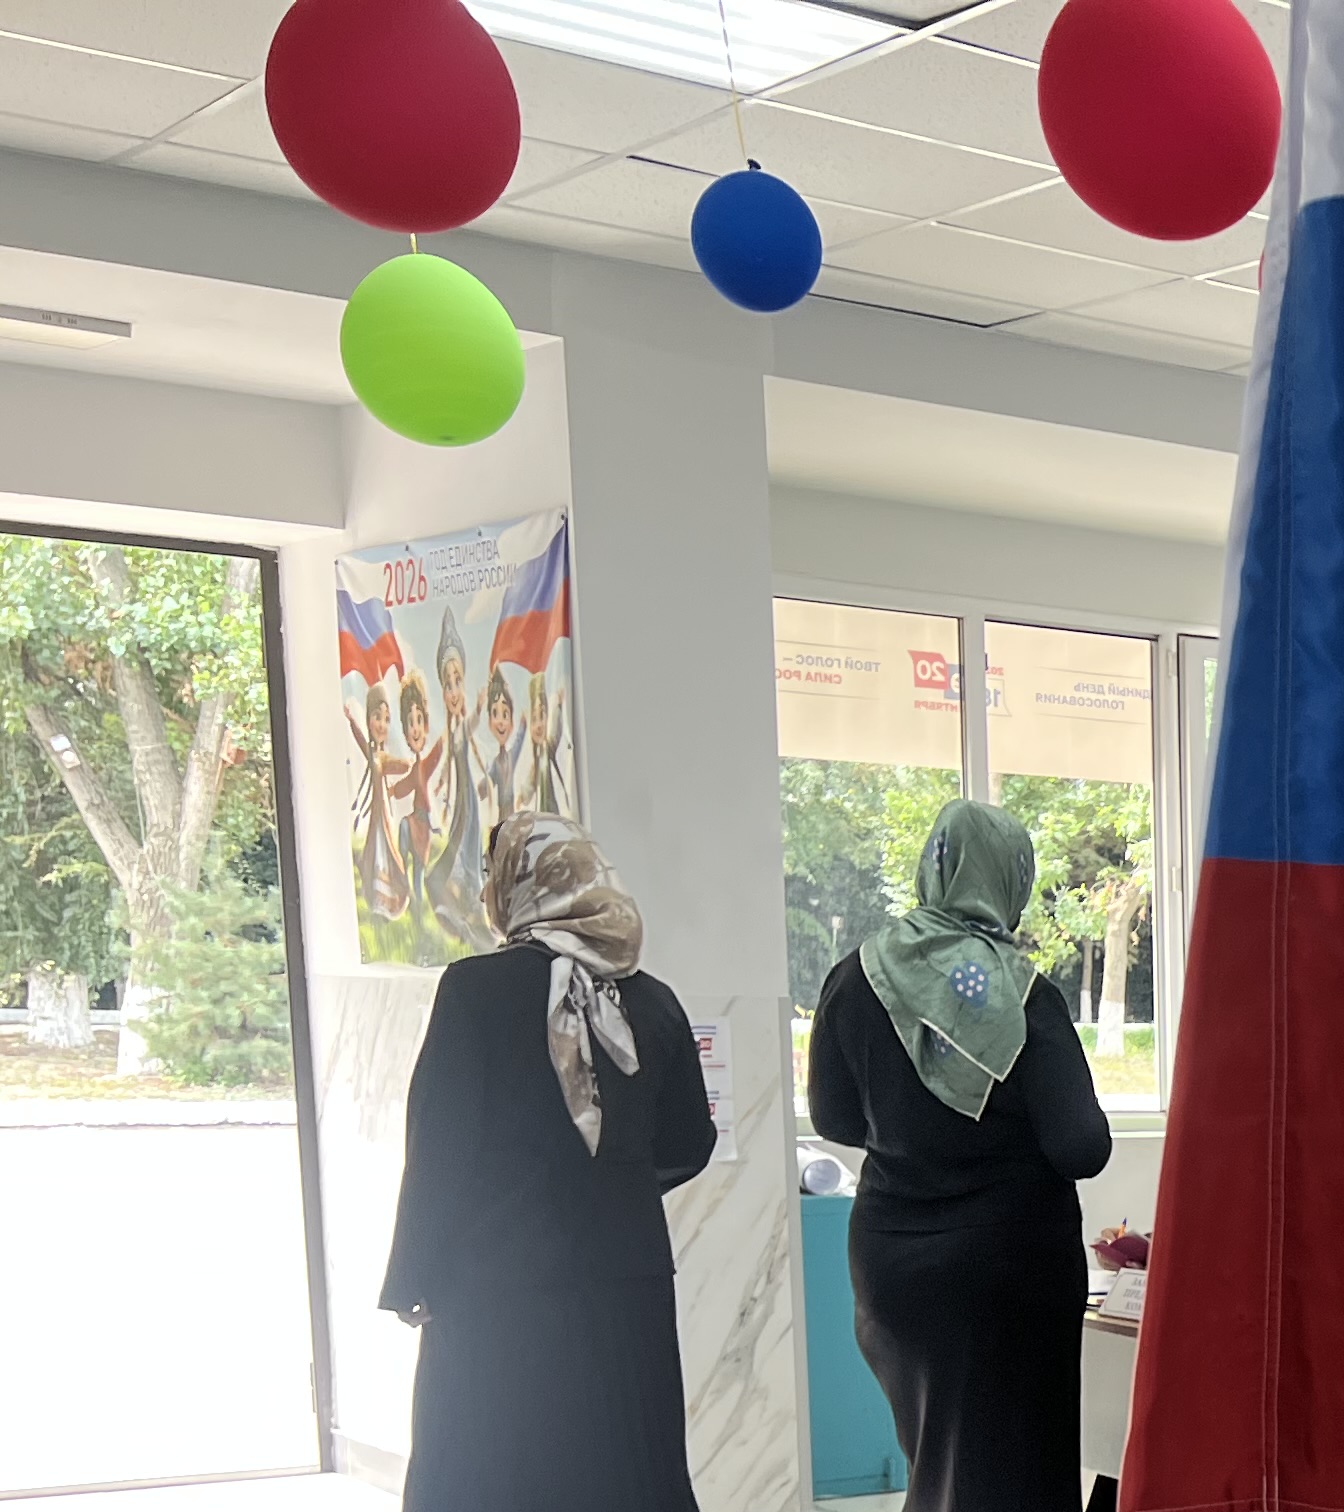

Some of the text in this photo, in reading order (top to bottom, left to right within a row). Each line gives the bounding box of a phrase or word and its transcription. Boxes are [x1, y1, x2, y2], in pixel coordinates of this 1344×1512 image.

[429, 539, 501, 571] ГОД ЕДИНСТВА
[383, 557, 428, 608] 2026
[433, 562, 518, 598] НАРОДОВ РОССИИ
